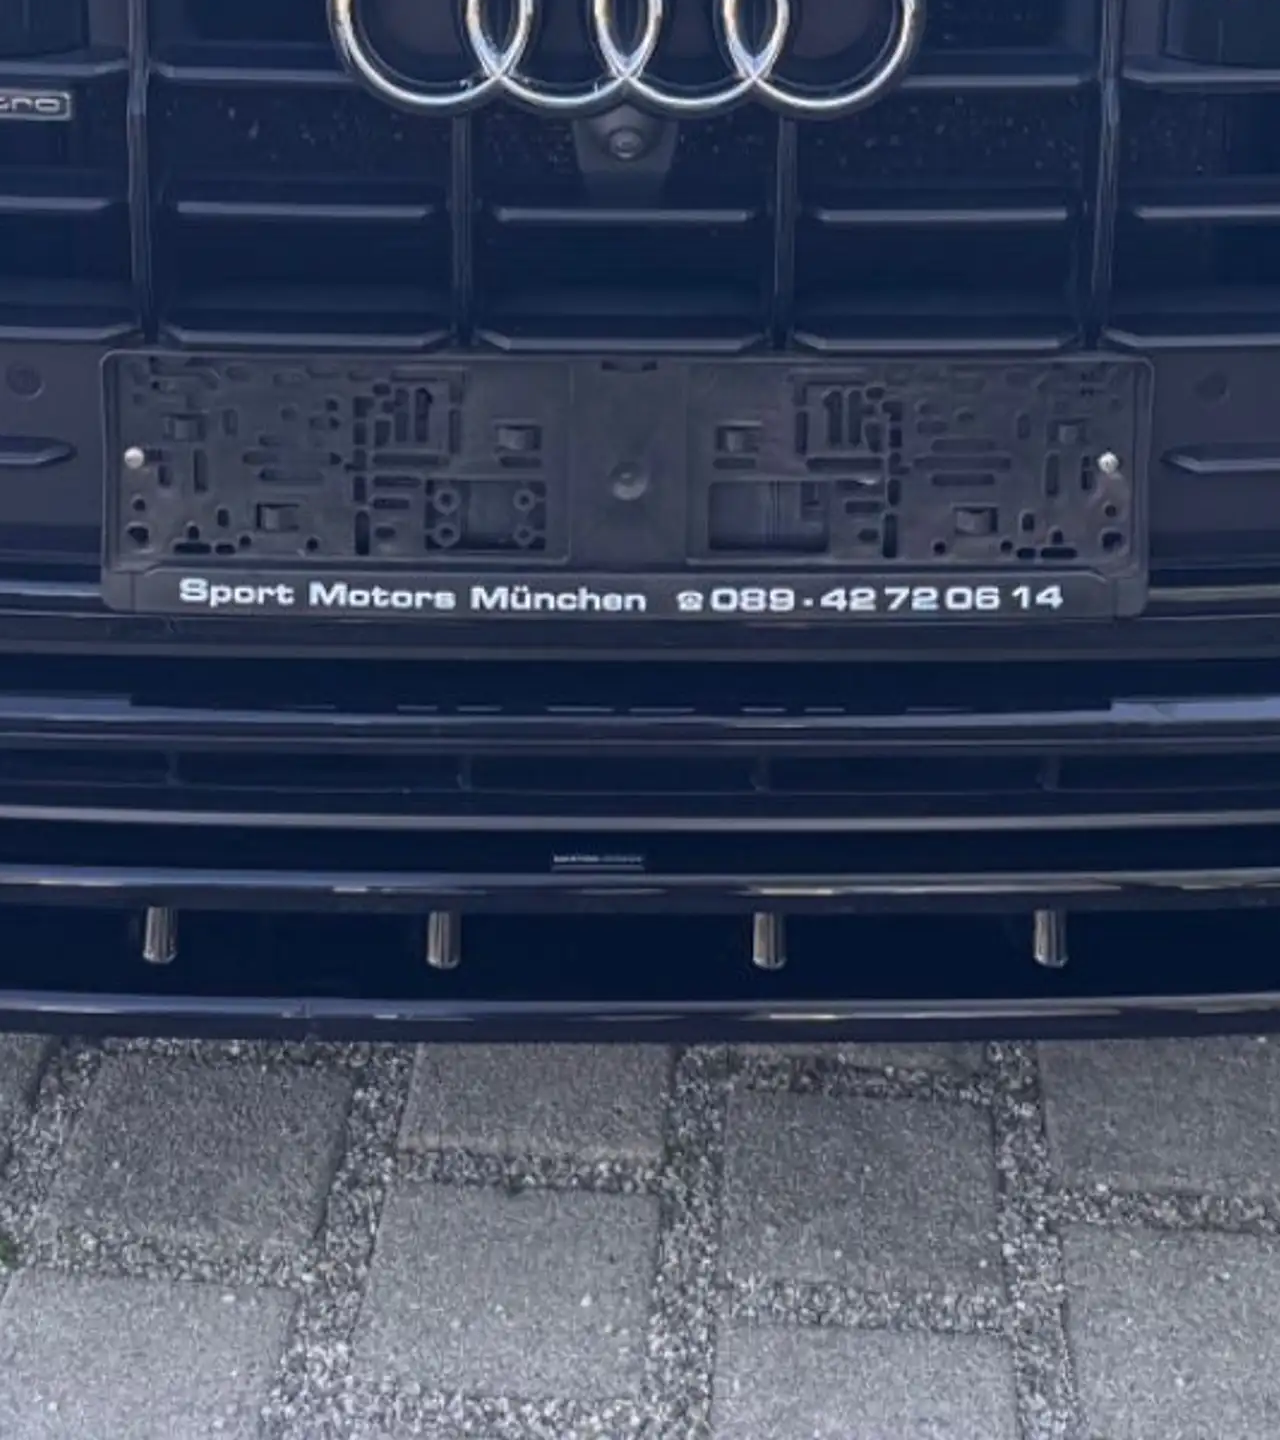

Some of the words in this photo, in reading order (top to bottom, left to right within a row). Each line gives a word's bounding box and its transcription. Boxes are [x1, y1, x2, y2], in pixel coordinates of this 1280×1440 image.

[178, 577, 295, 609] Sport
[309, 581, 457, 610] Motors
[470, 584, 647, 612] München
